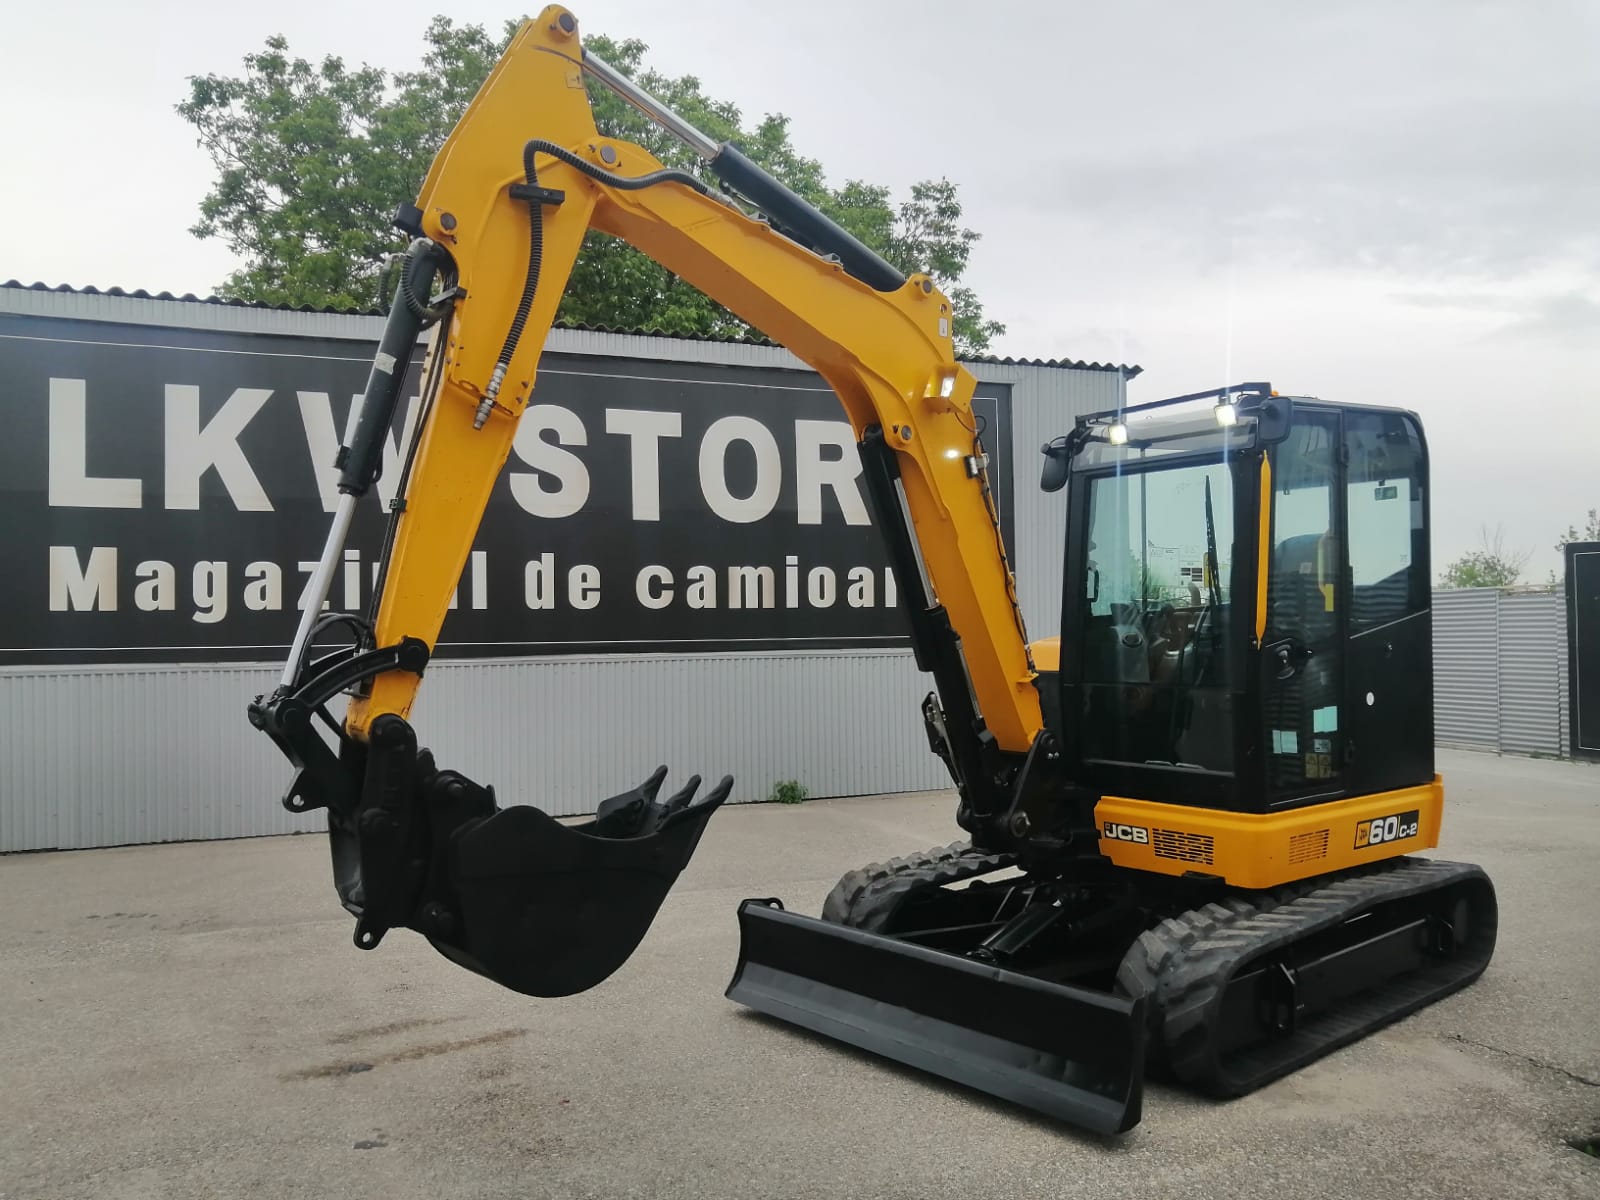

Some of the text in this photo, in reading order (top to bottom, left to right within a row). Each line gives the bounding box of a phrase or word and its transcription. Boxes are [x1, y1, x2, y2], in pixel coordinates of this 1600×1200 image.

[49, 546, 488, 623] Magazil
[525, 552, 601, 610] de
[1105, 823, 1148, 843] JCB
